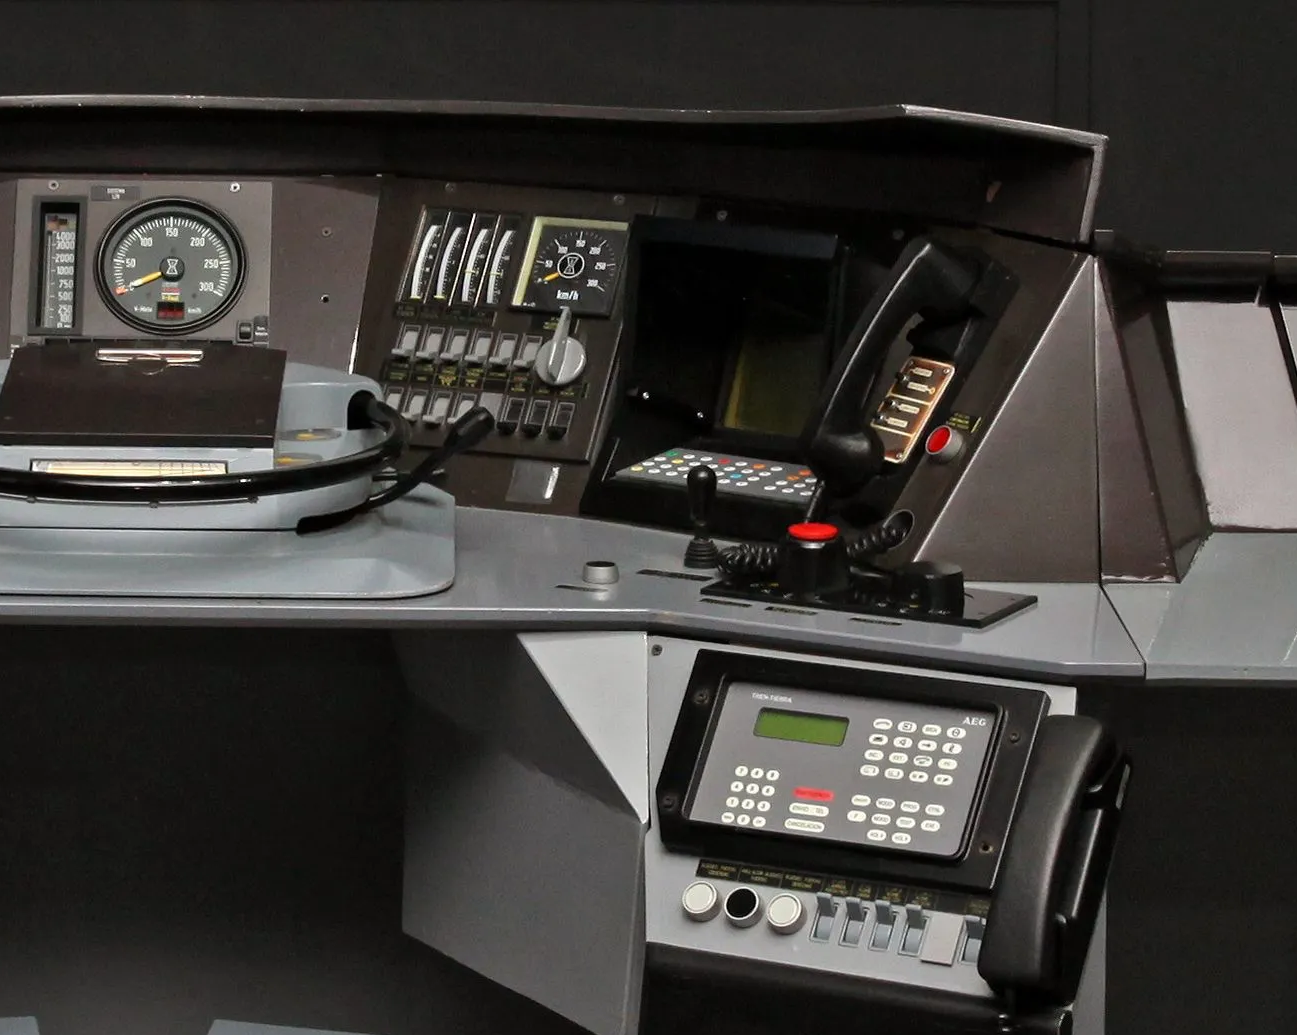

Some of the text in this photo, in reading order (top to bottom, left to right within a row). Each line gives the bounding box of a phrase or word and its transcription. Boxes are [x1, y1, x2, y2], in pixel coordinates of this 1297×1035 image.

[166, 228, 178, 237] 150
[141, 237, 153, 247] 100
[190, 237, 205, 247] 200
[55, 253, 75, 263] 2000
[126, 258, 136, 268] 50
[204, 259, 219, 269] 250
[59, 279, 74, 289] 750
[199, 282, 214, 292] 300
[58, 291, 73, 301] 500
[556, 289, 579, 301] km/h
[962, 716, 987, 726] AEG
